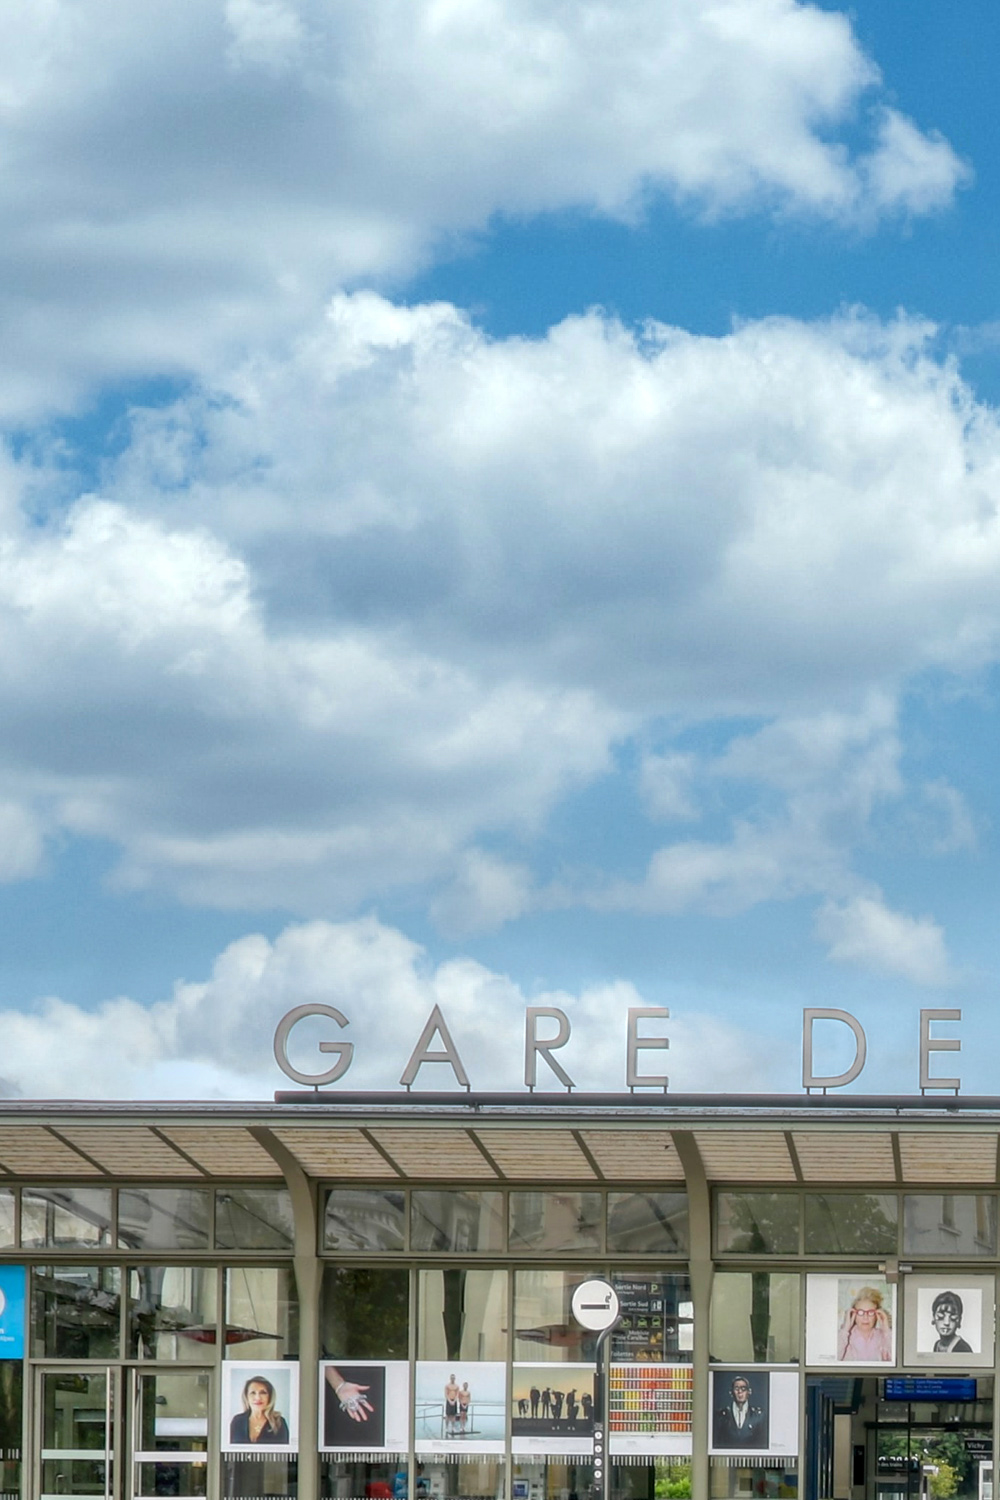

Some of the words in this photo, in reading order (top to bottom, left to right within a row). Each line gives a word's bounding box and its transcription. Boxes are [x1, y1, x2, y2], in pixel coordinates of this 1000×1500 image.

[274, 1003, 669, 1087] GARE
[803, 1008, 961, 1090] DE
[967, 1442, 985, 1450] Vichy
